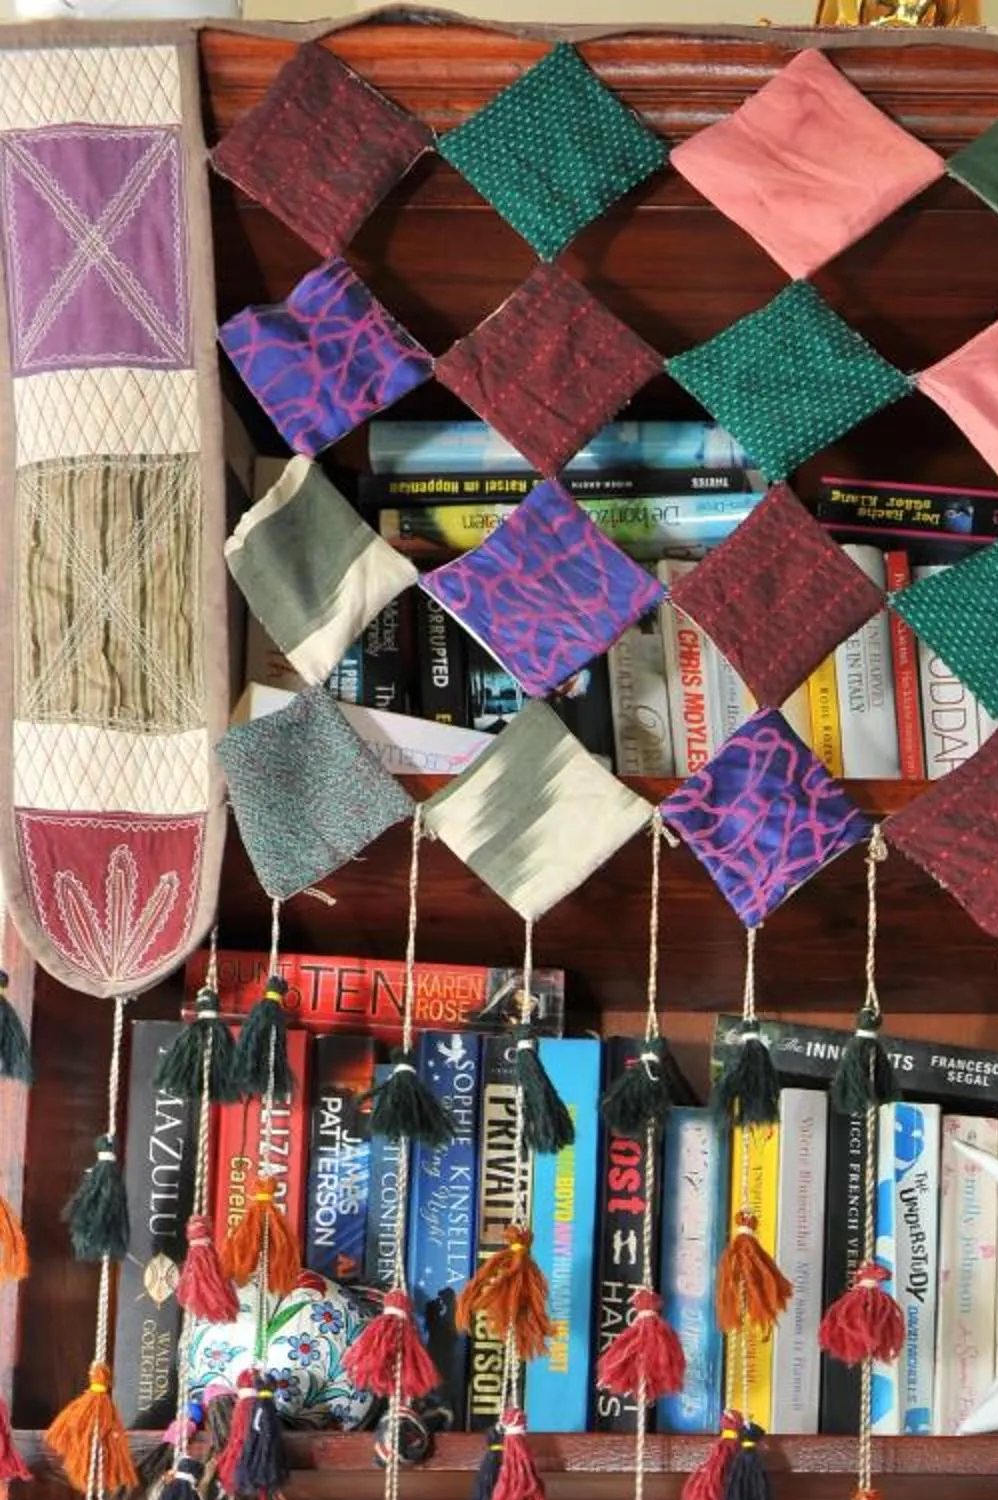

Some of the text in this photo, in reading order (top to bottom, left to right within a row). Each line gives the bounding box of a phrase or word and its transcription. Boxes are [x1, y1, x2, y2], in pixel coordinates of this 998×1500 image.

[678, 630, 708, 773] CHRIS MOYLES
[847, 673, 864, 713] ITALY
[868, 654, 884, 708] HARVEY
[301, 965, 402, 1016] TEN
[415, 999, 468, 1022] ROSE
[417, 974, 481, 998] KAREN
[946, 1071, 991, 1088] SEGAL
[314, 1097, 341, 1246] PATTERSON
[337, 1129, 362, 1215] JAMES
[447, 1059, 474, 1285] SOPHIE KINSELLA
[846, 1163, 859, 1230] FRENCH
[913, 1171, 928, 1194] THE
[899, 1188, 928, 1303] UNDERSTUDY
[137, 1319, 155, 1413] GOLIGHTLY
[154, 1331, 170, 1401] WALTON
